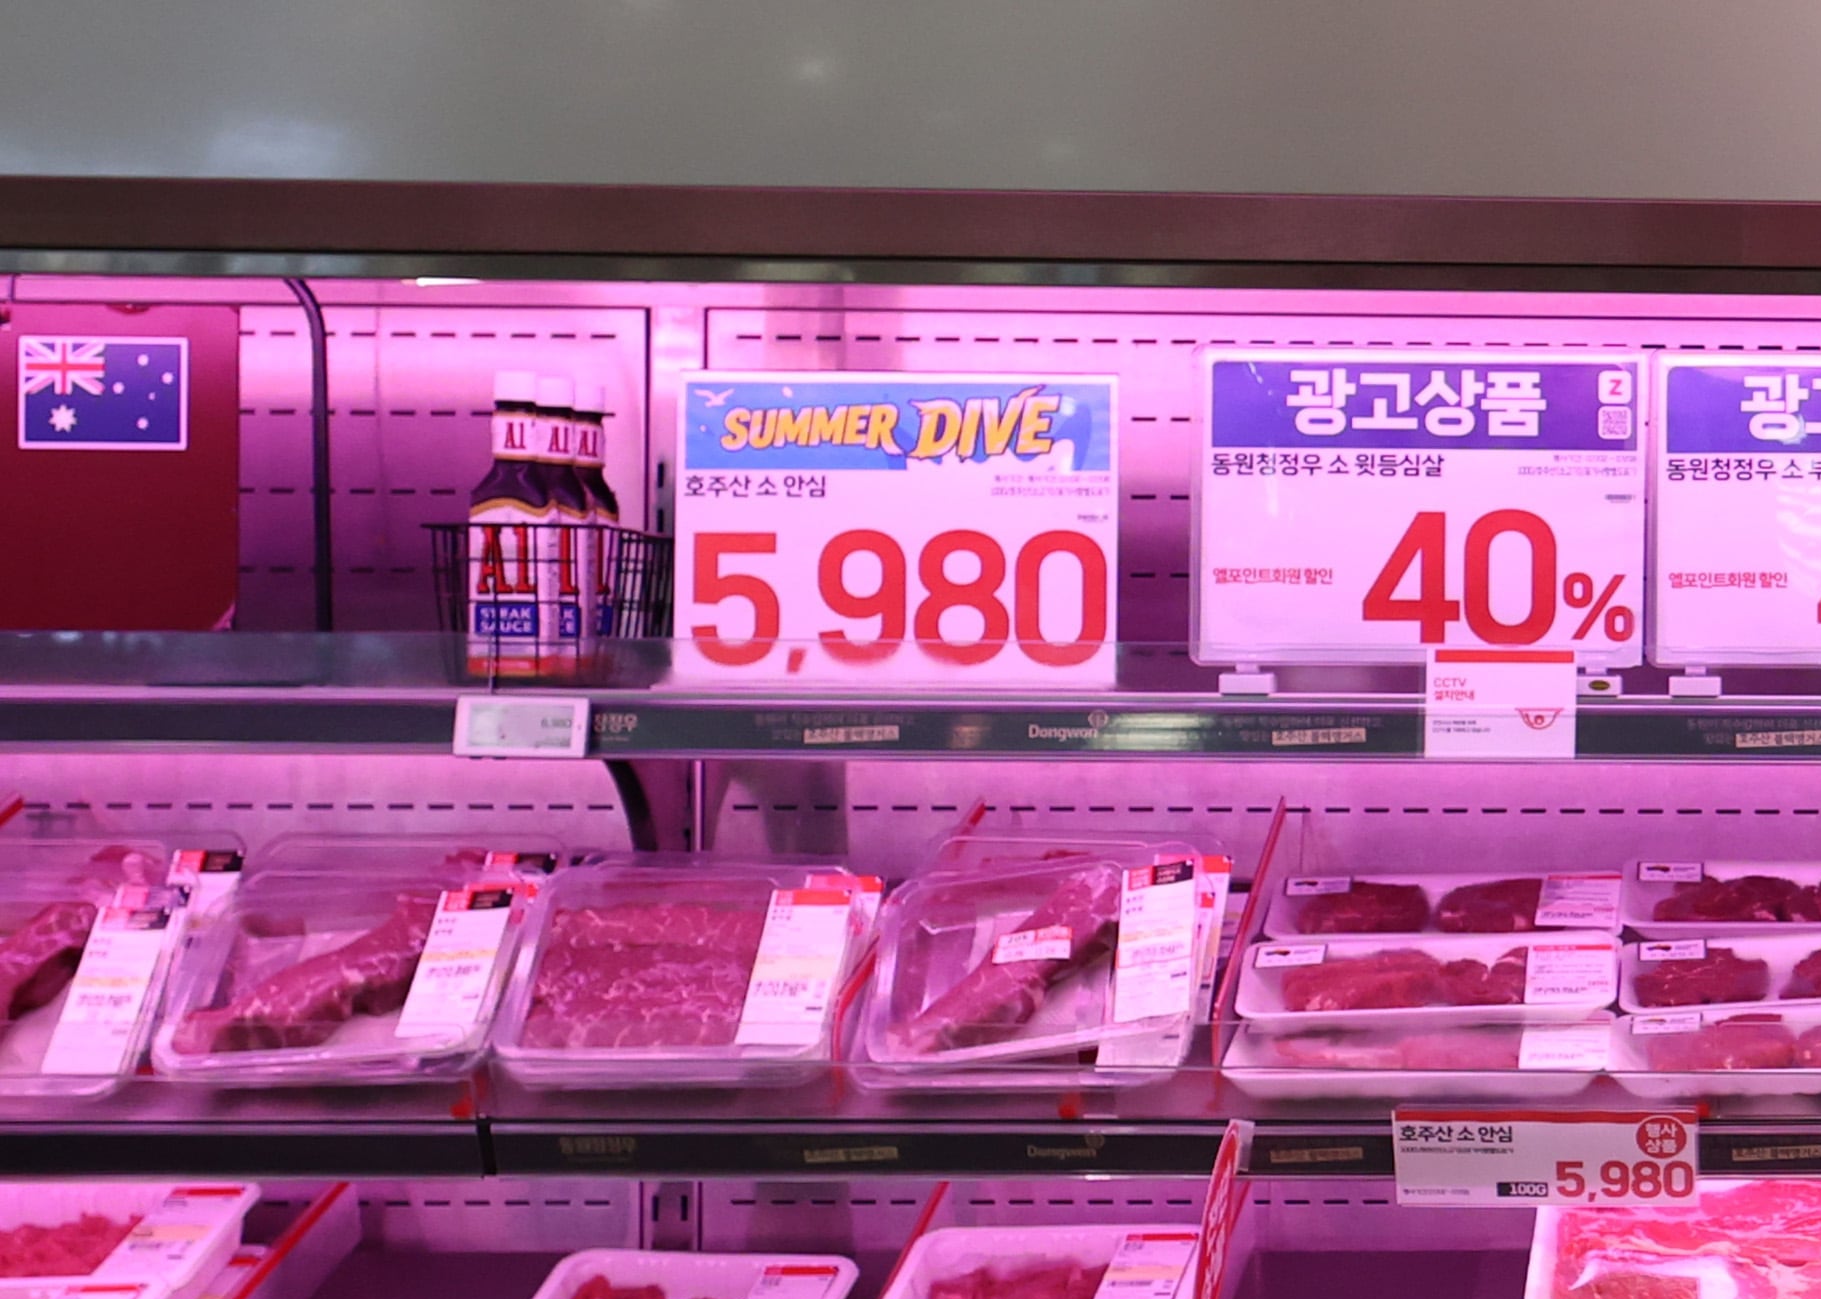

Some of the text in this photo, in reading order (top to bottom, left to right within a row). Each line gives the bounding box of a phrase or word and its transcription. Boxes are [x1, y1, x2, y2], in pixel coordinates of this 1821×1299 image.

[1286, 368, 1547, 437] 광고상품
[720, 385, 1063, 462] SUMMER DIVE
[1212, 453, 1445, 477] 동원청정우 소 윗등심살
[1666, 458, 1776, 481] 동원청정우
[1782, 459, 1804, 480] 소
[685, 474, 827, 499] 호주산 소 안심
[1304, 567, 1333, 585] 할인
[1362, 509, 1635, 645] 40%
[1759, 571, 1788, 589] 할인
[691, 529, 1108, 675] 5,980
[1433, 677, 1467, 688] CCTV
[1028, 724, 1098, 743] Dongwon
[1400, 1125, 1513, 1143] 호주산 소 안심
[1508, 1160, 1694, 1203] 100G 5,980
